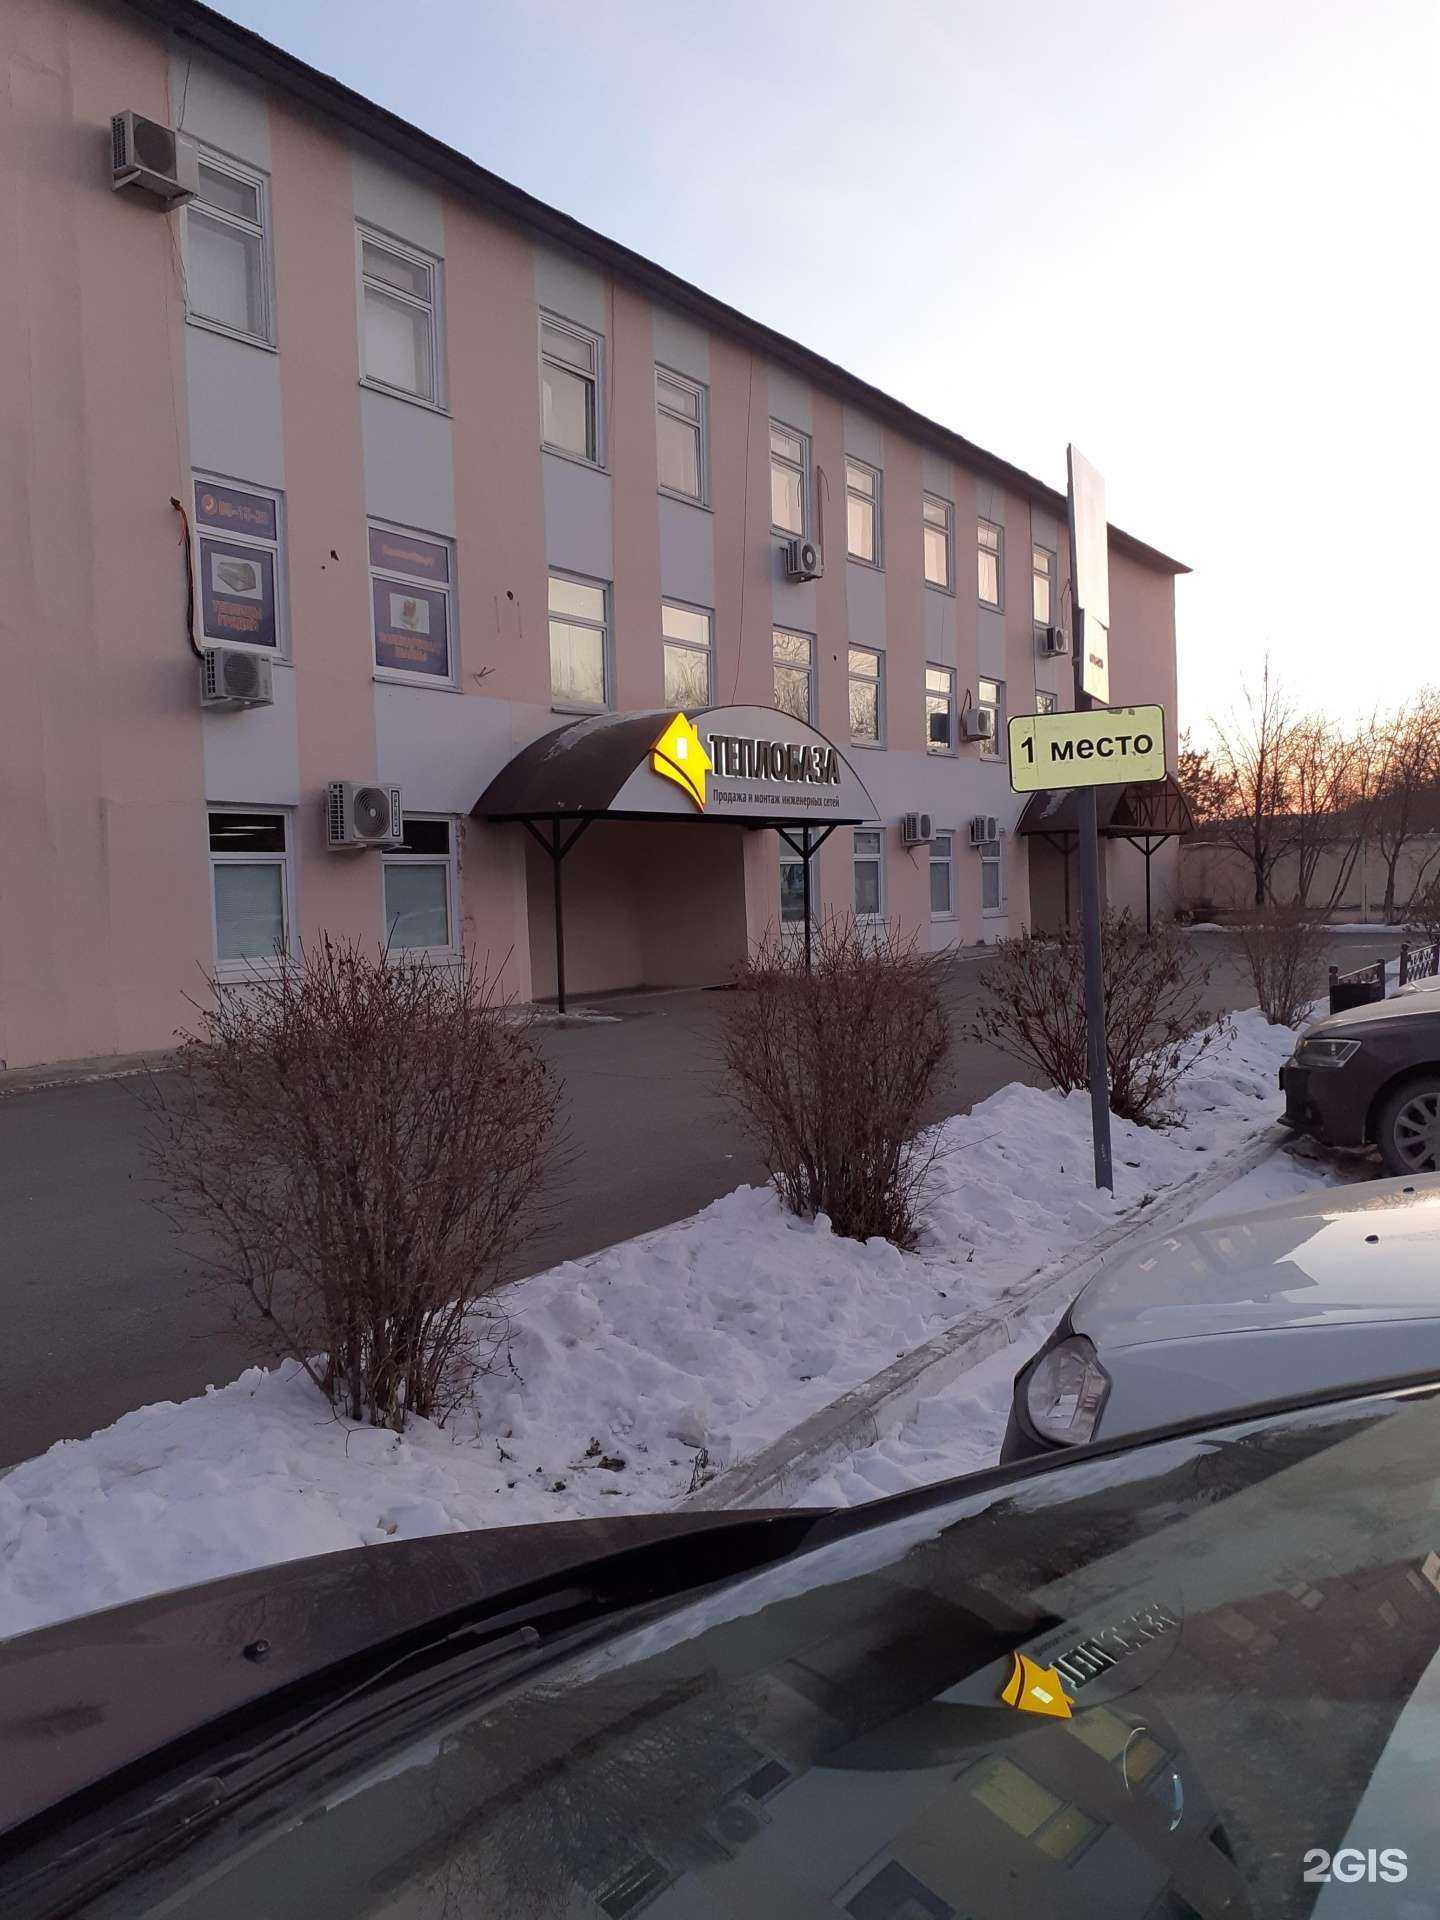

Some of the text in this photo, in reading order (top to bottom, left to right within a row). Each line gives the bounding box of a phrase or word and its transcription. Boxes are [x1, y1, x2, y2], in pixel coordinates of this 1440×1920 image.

[708, 733, 841, 785] ТЕПЛОБАЗА
[1021, 734, 1153, 763] 1 место
[713, 788, 747, 805] Продажа
[754, 794, 781, 805] монтаж
[782, 795, 823, 809] инженерных
[823, 795, 840, 808] сетей
